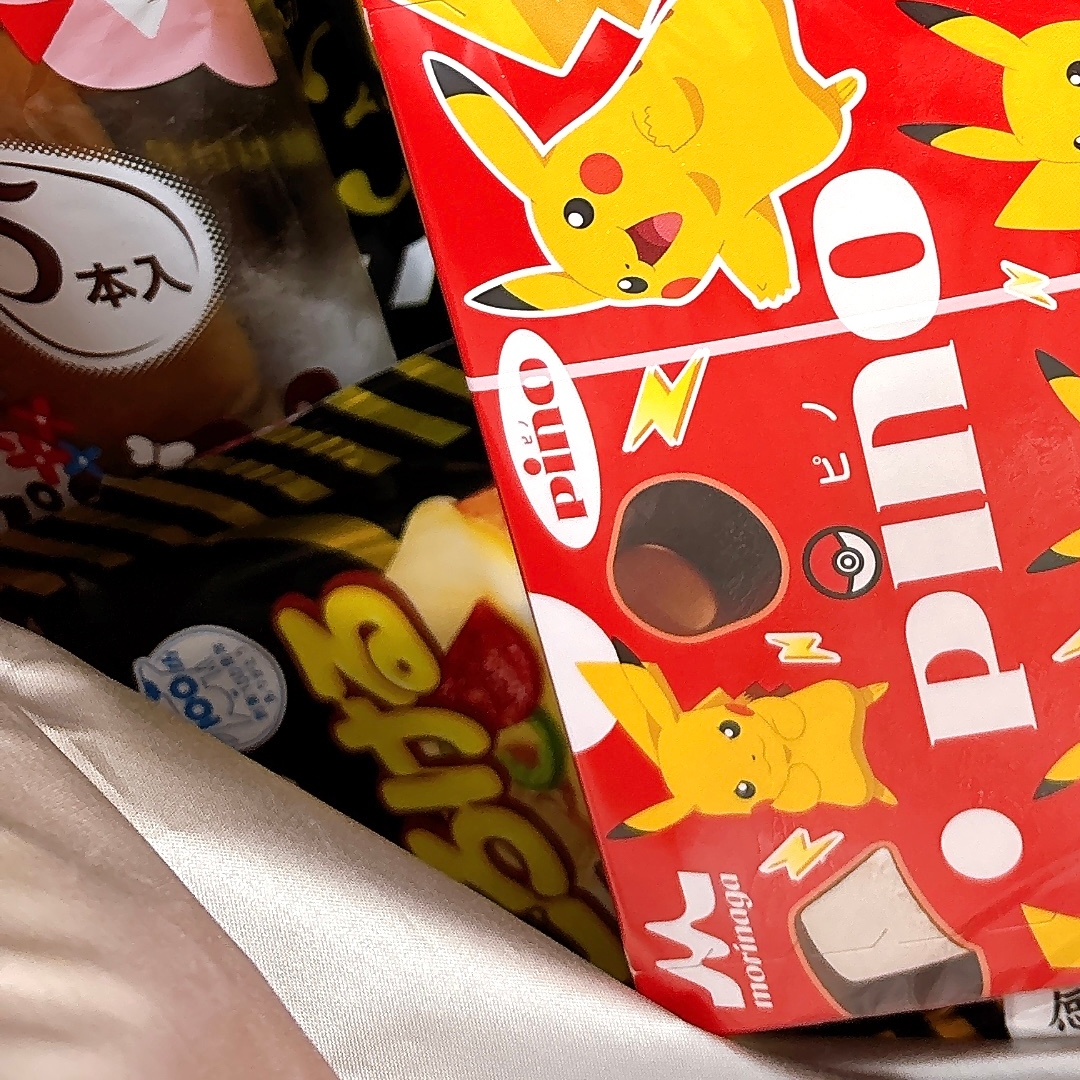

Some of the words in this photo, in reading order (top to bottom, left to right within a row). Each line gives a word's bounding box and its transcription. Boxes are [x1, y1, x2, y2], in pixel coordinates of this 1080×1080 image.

[518, 357, 589, 521] pino
[801, 401, 852, 486] ピノ
[812, 167, 1038, 748] pino
[719, 872, 774, 1010] morinaga
